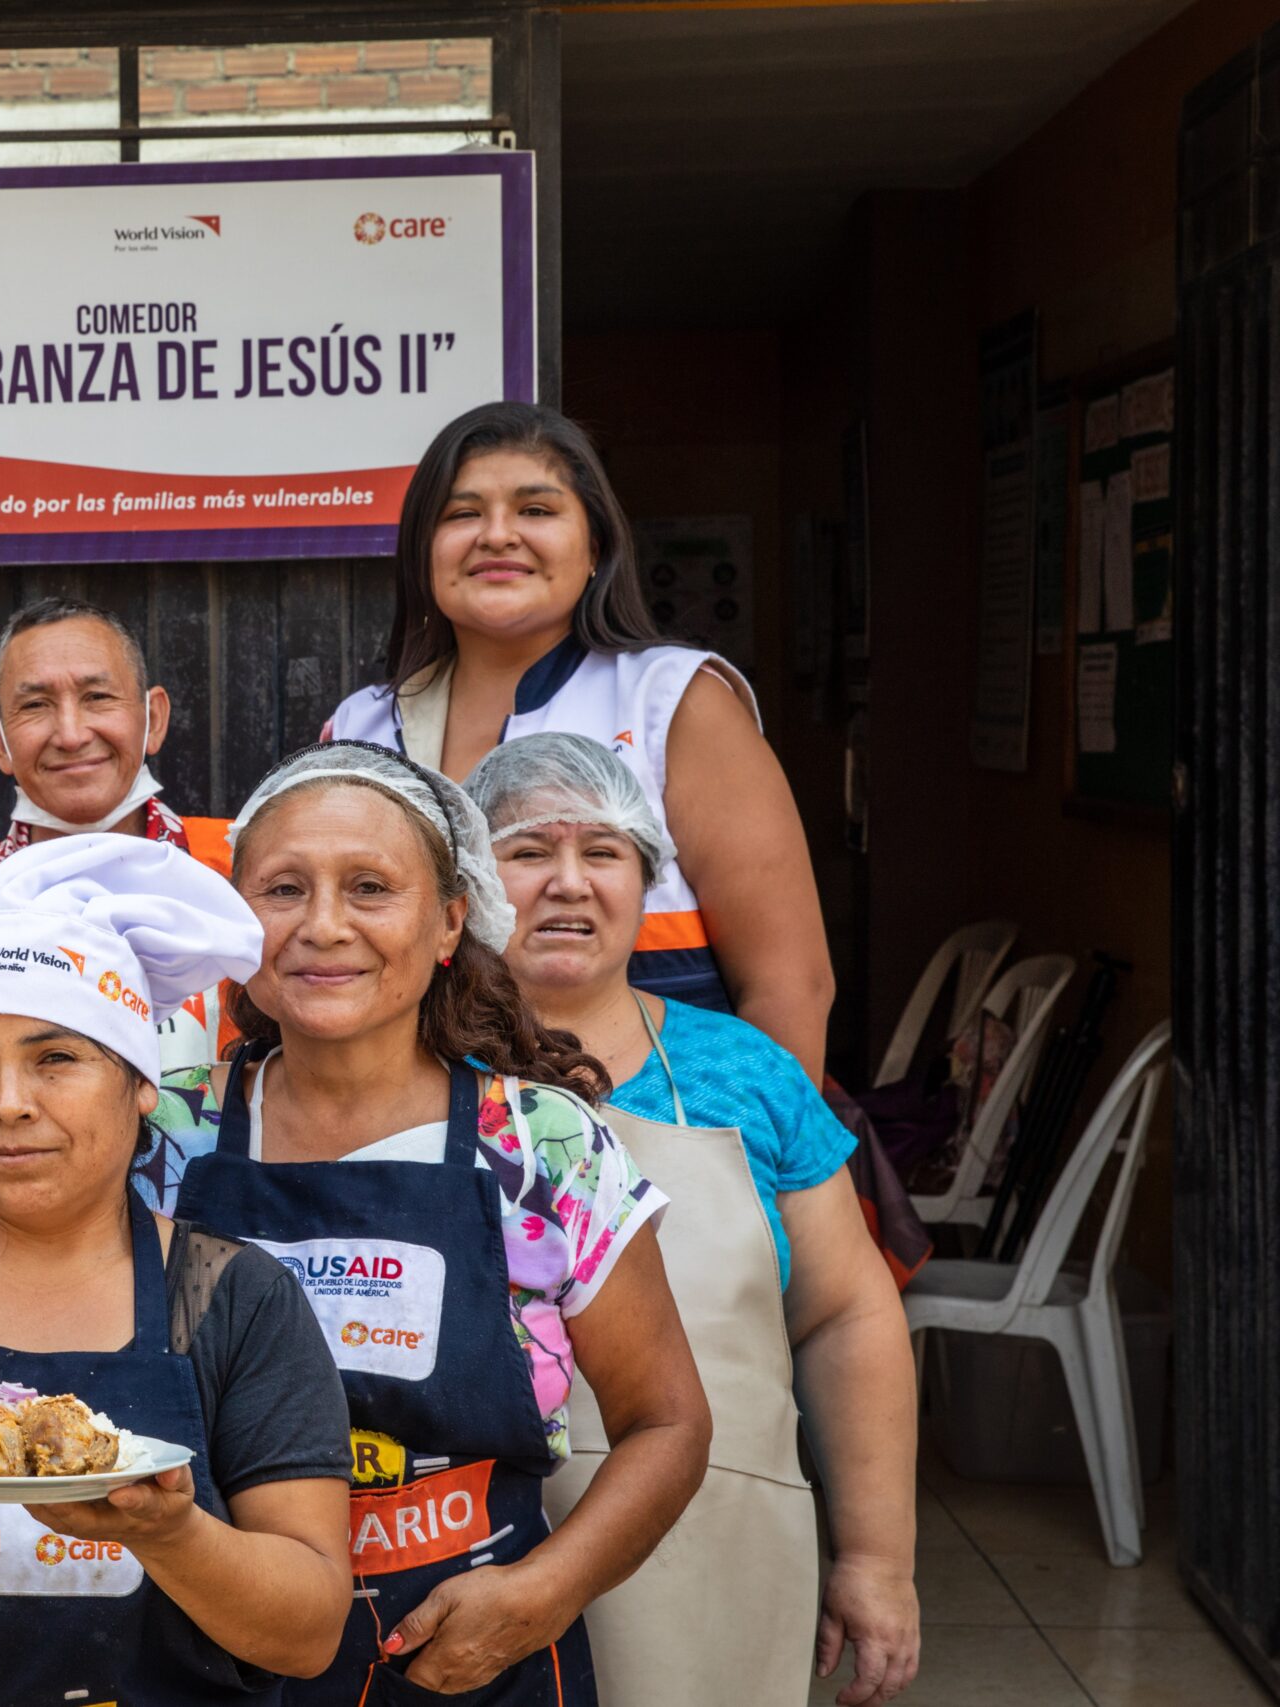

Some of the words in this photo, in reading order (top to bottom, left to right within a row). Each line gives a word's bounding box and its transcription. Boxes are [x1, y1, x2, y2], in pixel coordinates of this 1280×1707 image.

[114, 226, 158, 240] World
[161, 226, 205, 239] Vision
[389, 217, 446, 238] care
[76, 302, 197, 335] COMEDOR
[157, 339, 218, 400] DE
[234, 323, 382, 399] JESÚS
[33, 497, 70, 518] por
[76, 493, 105, 512] las
[112, 491, 196, 516] familias
[203, 489, 245, 508] más
[252, 486, 373, 508] vulnerables
[32, 951, 71, 972] Vision
[122, 987, 149, 1022] care
[307, 1256, 403, 1279] USAID
[369, 1280, 402, 1289] ESTADOS
[370, 1327, 418, 1350] care
[68, 1540, 123, 1561] care
